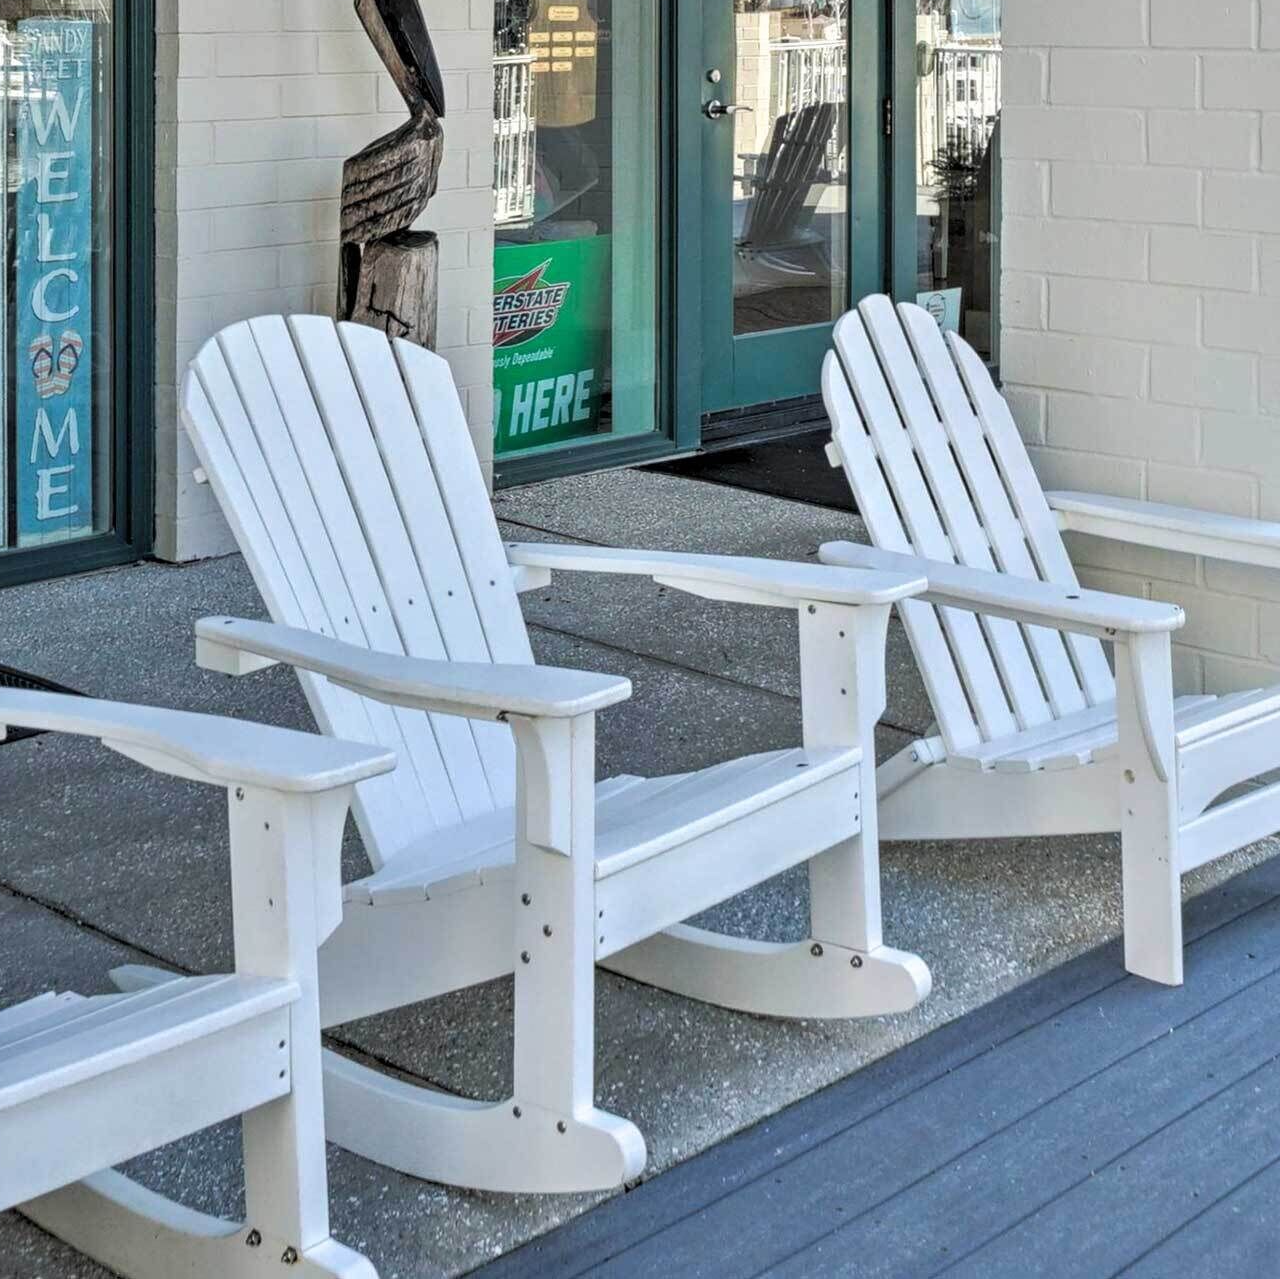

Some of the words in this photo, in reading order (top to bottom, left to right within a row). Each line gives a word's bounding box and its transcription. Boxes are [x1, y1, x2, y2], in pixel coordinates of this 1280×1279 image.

[494, 287, 564, 312] ERSTATE
[494, 308, 554, 332] TERIES
[508, 368, 595, 437] HERE
